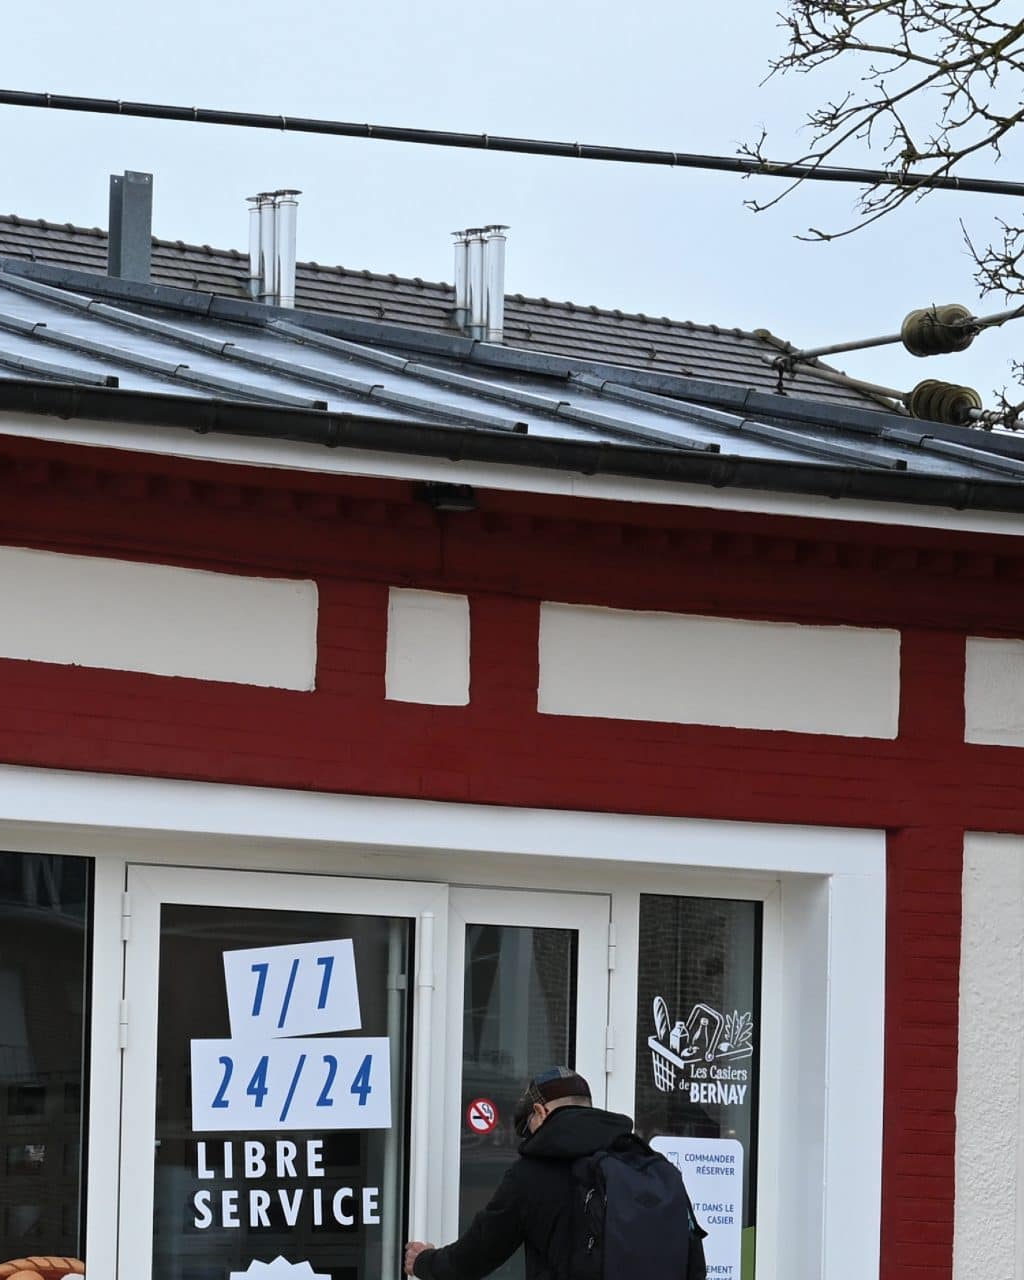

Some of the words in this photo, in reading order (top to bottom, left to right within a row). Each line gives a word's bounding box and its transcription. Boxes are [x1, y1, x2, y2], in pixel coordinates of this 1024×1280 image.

[691, 1064, 707, 1079] Les
[710, 1065, 747, 1080] Casiers
[212, 1054, 372, 1122] 24/24
[679, 1079, 689, 1090] de
[690, 1080, 746, 1105] BERNAY
[198, 1141, 324, 1178] LIBRE
[685, 1153, 735, 1163] COMMANDER
[696, 1164, 735, 1175] RÉSERVER
[194, 1188, 379, 1228] SERVICE
[702, 1203, 722, 1212] DANS
[725, 1204, 734, 1212] LE
[707, 1215, 734, 1224] CASIER
[706, 1265, 732, 1274] EMENT
